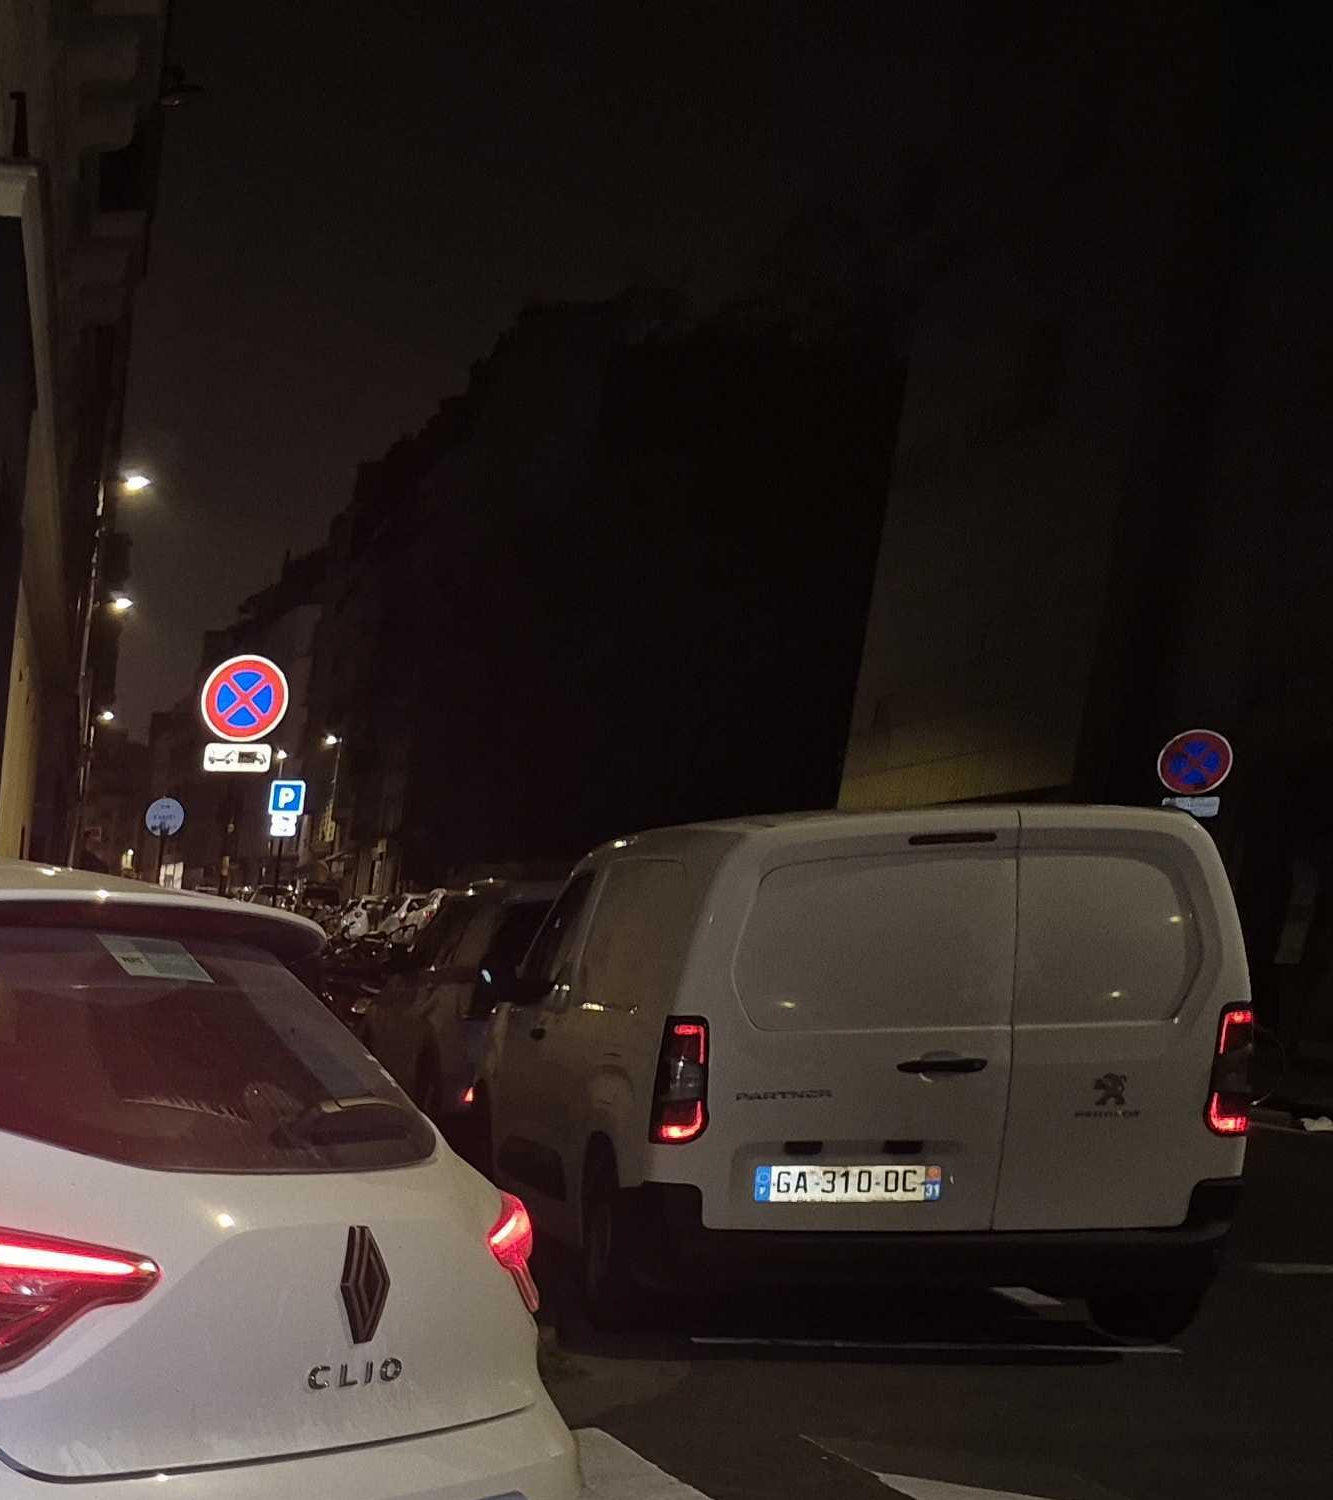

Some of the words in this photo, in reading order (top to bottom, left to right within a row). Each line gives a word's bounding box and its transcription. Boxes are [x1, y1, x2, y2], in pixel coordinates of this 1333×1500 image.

[278, 787, 296, 809] P
[925, 1184, 940, 1198] 31
[306, 1357, 403, 1391] CLIO
